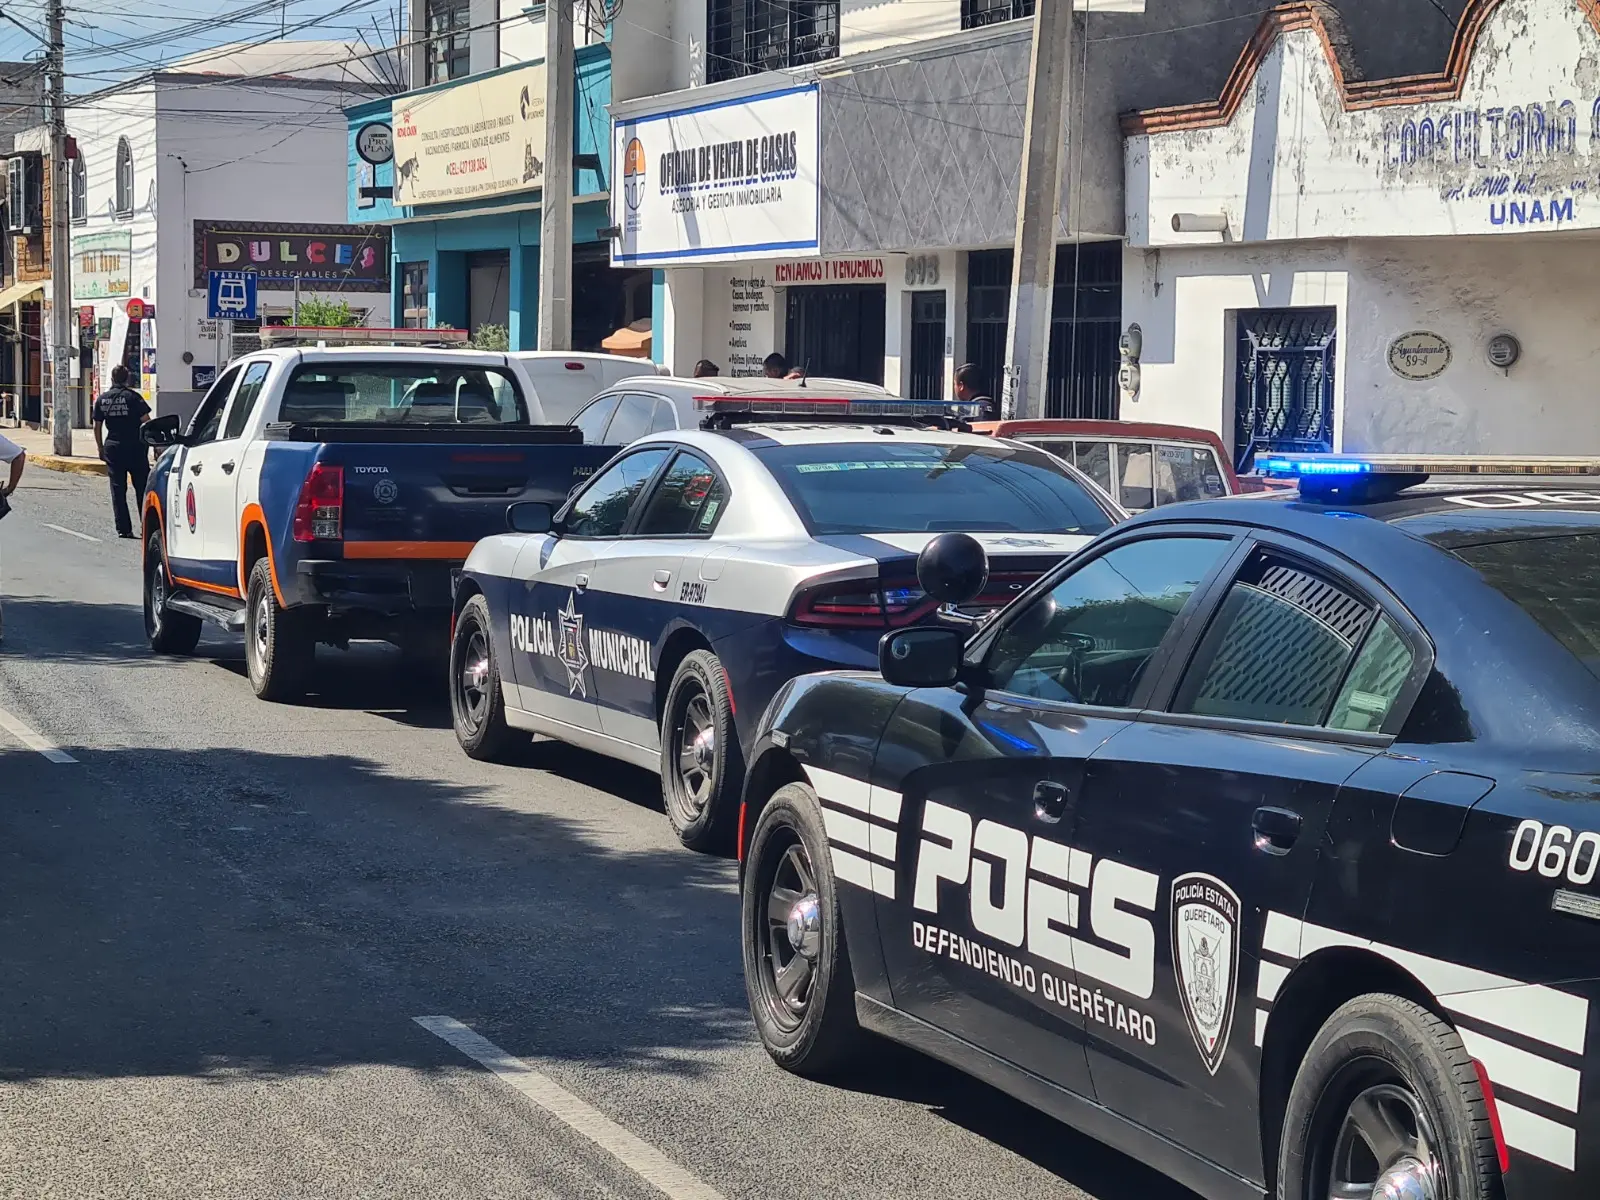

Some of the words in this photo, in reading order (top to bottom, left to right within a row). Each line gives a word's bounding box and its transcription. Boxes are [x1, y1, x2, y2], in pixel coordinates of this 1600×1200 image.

[364, 145, 392, 153] PLAN
[368, 138, 388, 146] PRO
[660, 148, 697, 190] OFICINA
[698, 145, 711, 184] DE
[712, 141, 744, 181] VENTA
[746, 138, 759, 178] DE
[760, 130, 797, 175] CASAS
[672, 197, 700, 213] ASESORIA
[701, 196, 706, 210] Y
[708, 192, 735, 210] GESTION
[736, 186, 783, 206] INMOBILIARIA
[216, 240, 376, 269] DULCES
[214, 272, 252, 280] PARADA
[260, 269, 338, 279] DESECHABLES
[1394, 342, 1445, 358] Ayuntamiento
[353, 466, 389, 474] TOYOTA
[510, 611, 556, 658] POLICÍA
[588, 628, 656, 682] MUNICIPAL
[1509, 819, 1600, 885] 060
[913, 800, 1160, 999] POES
[1175, 882, 1204, 903] POLICÍA
[1205, 887, 1236, 923] ESTATAL
[1184, 908, 1225, 934] QUERÉTARO
[912, 921, 1036, 993] DEFENDIENDO
[1041, 971, 1157, 1046] QUERÉTARO
